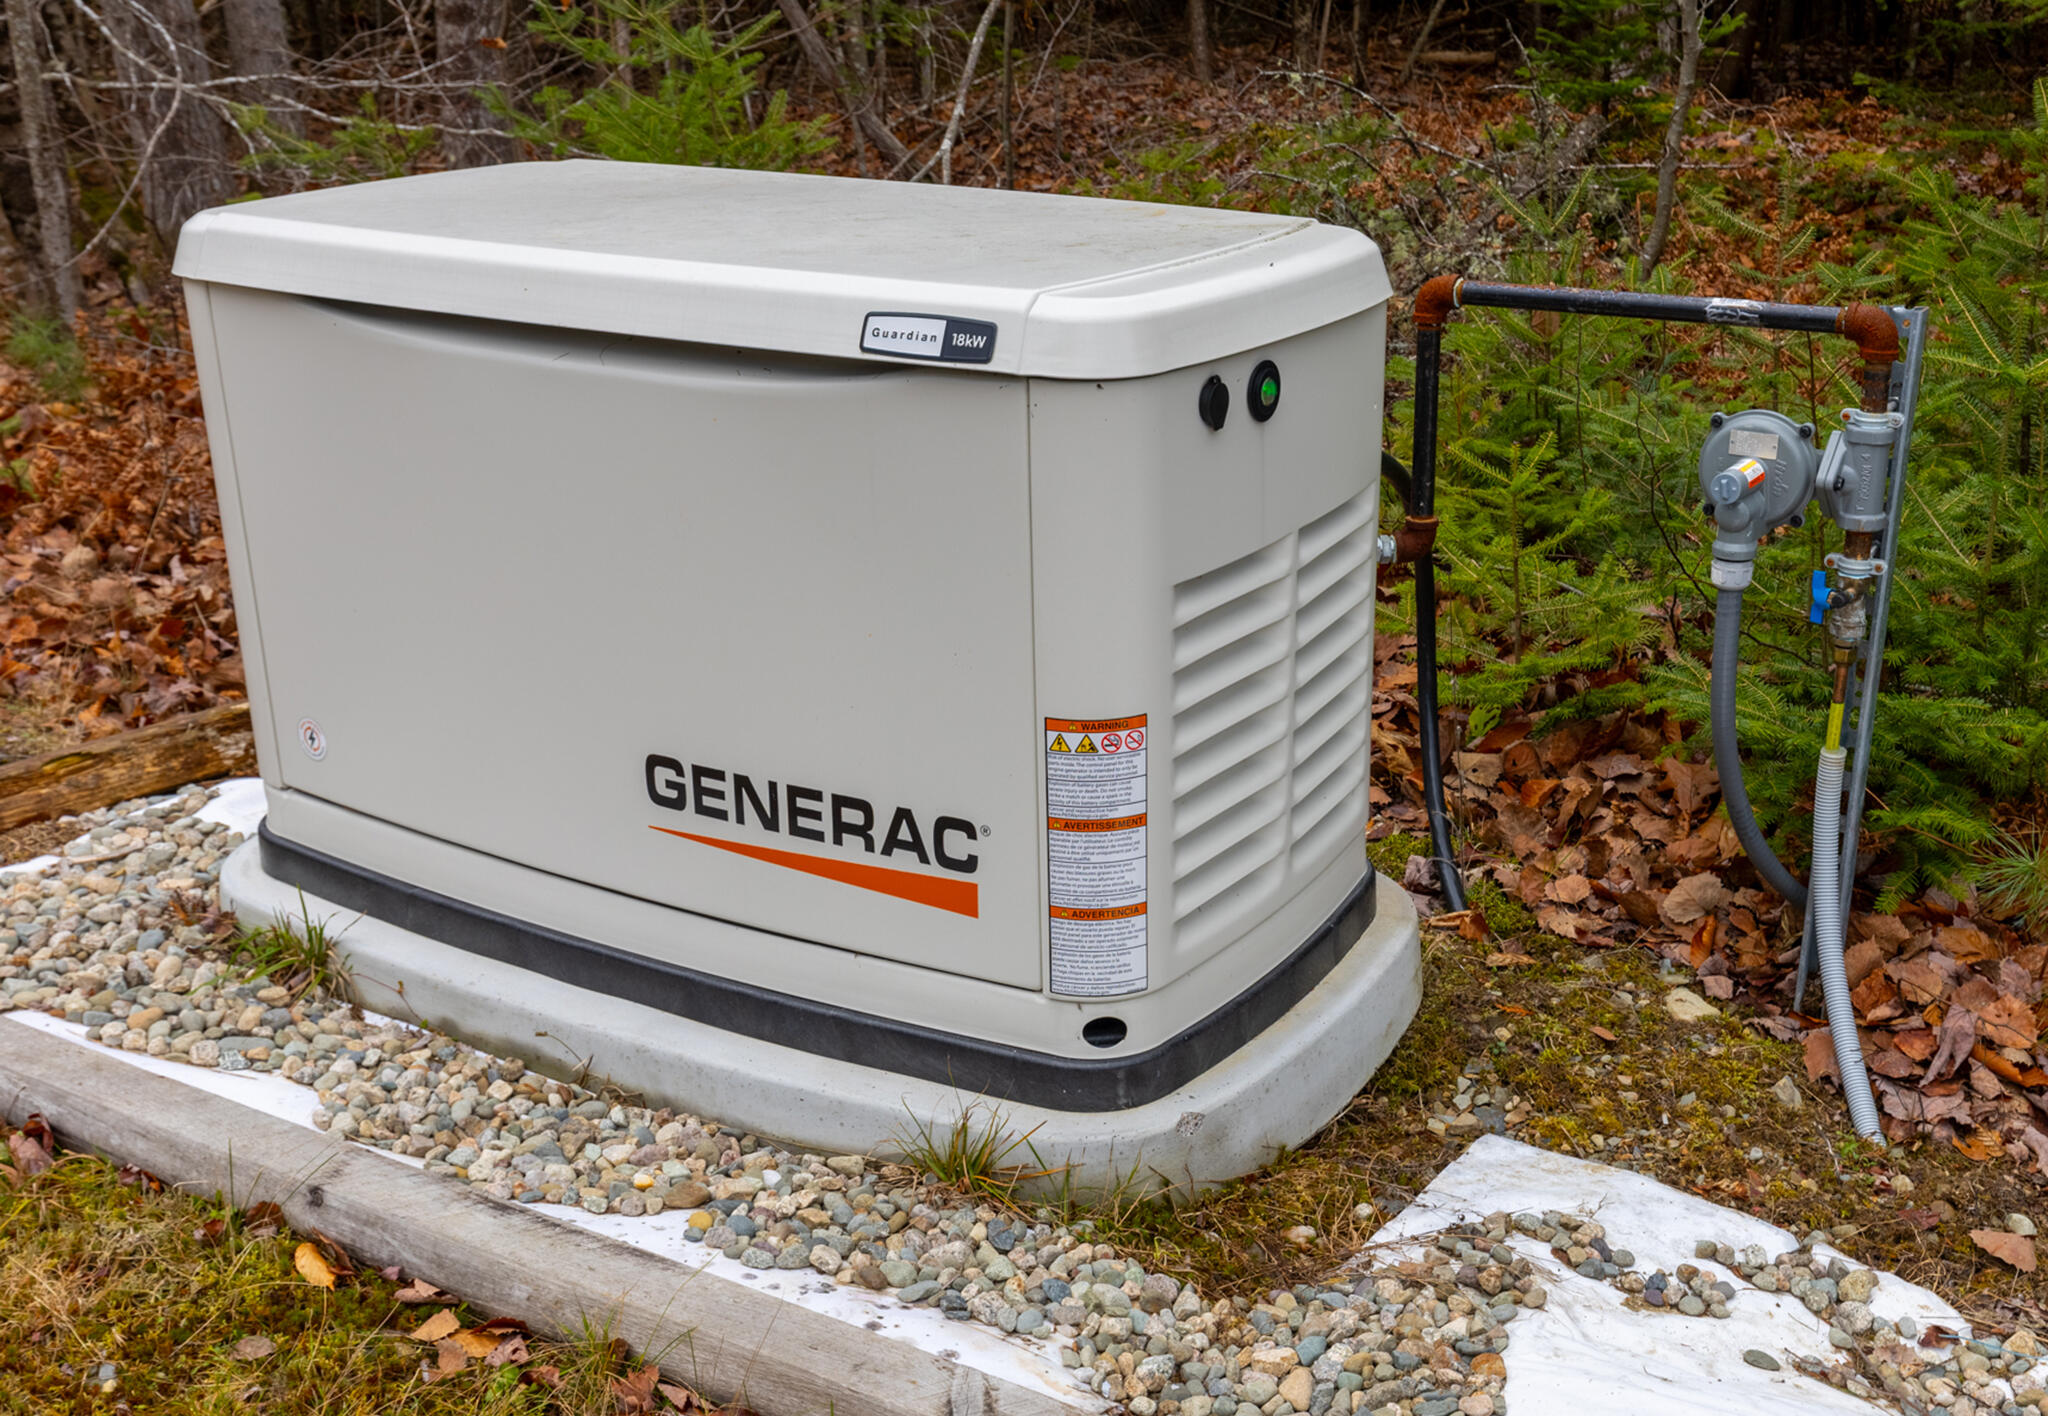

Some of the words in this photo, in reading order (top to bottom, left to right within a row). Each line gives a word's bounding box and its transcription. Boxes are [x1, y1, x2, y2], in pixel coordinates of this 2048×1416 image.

[872, 327, 937, 343] Guardian
[951, 333, 987, 349] 18kW
[1081, 720, 1129, 731] WARNING
[645, 753, 979, 874] GENERAC
[1063, 816, 1144, 830] AVERTISSEMENT
[1072, 906, 1140, 919] ADVERTENCIA
